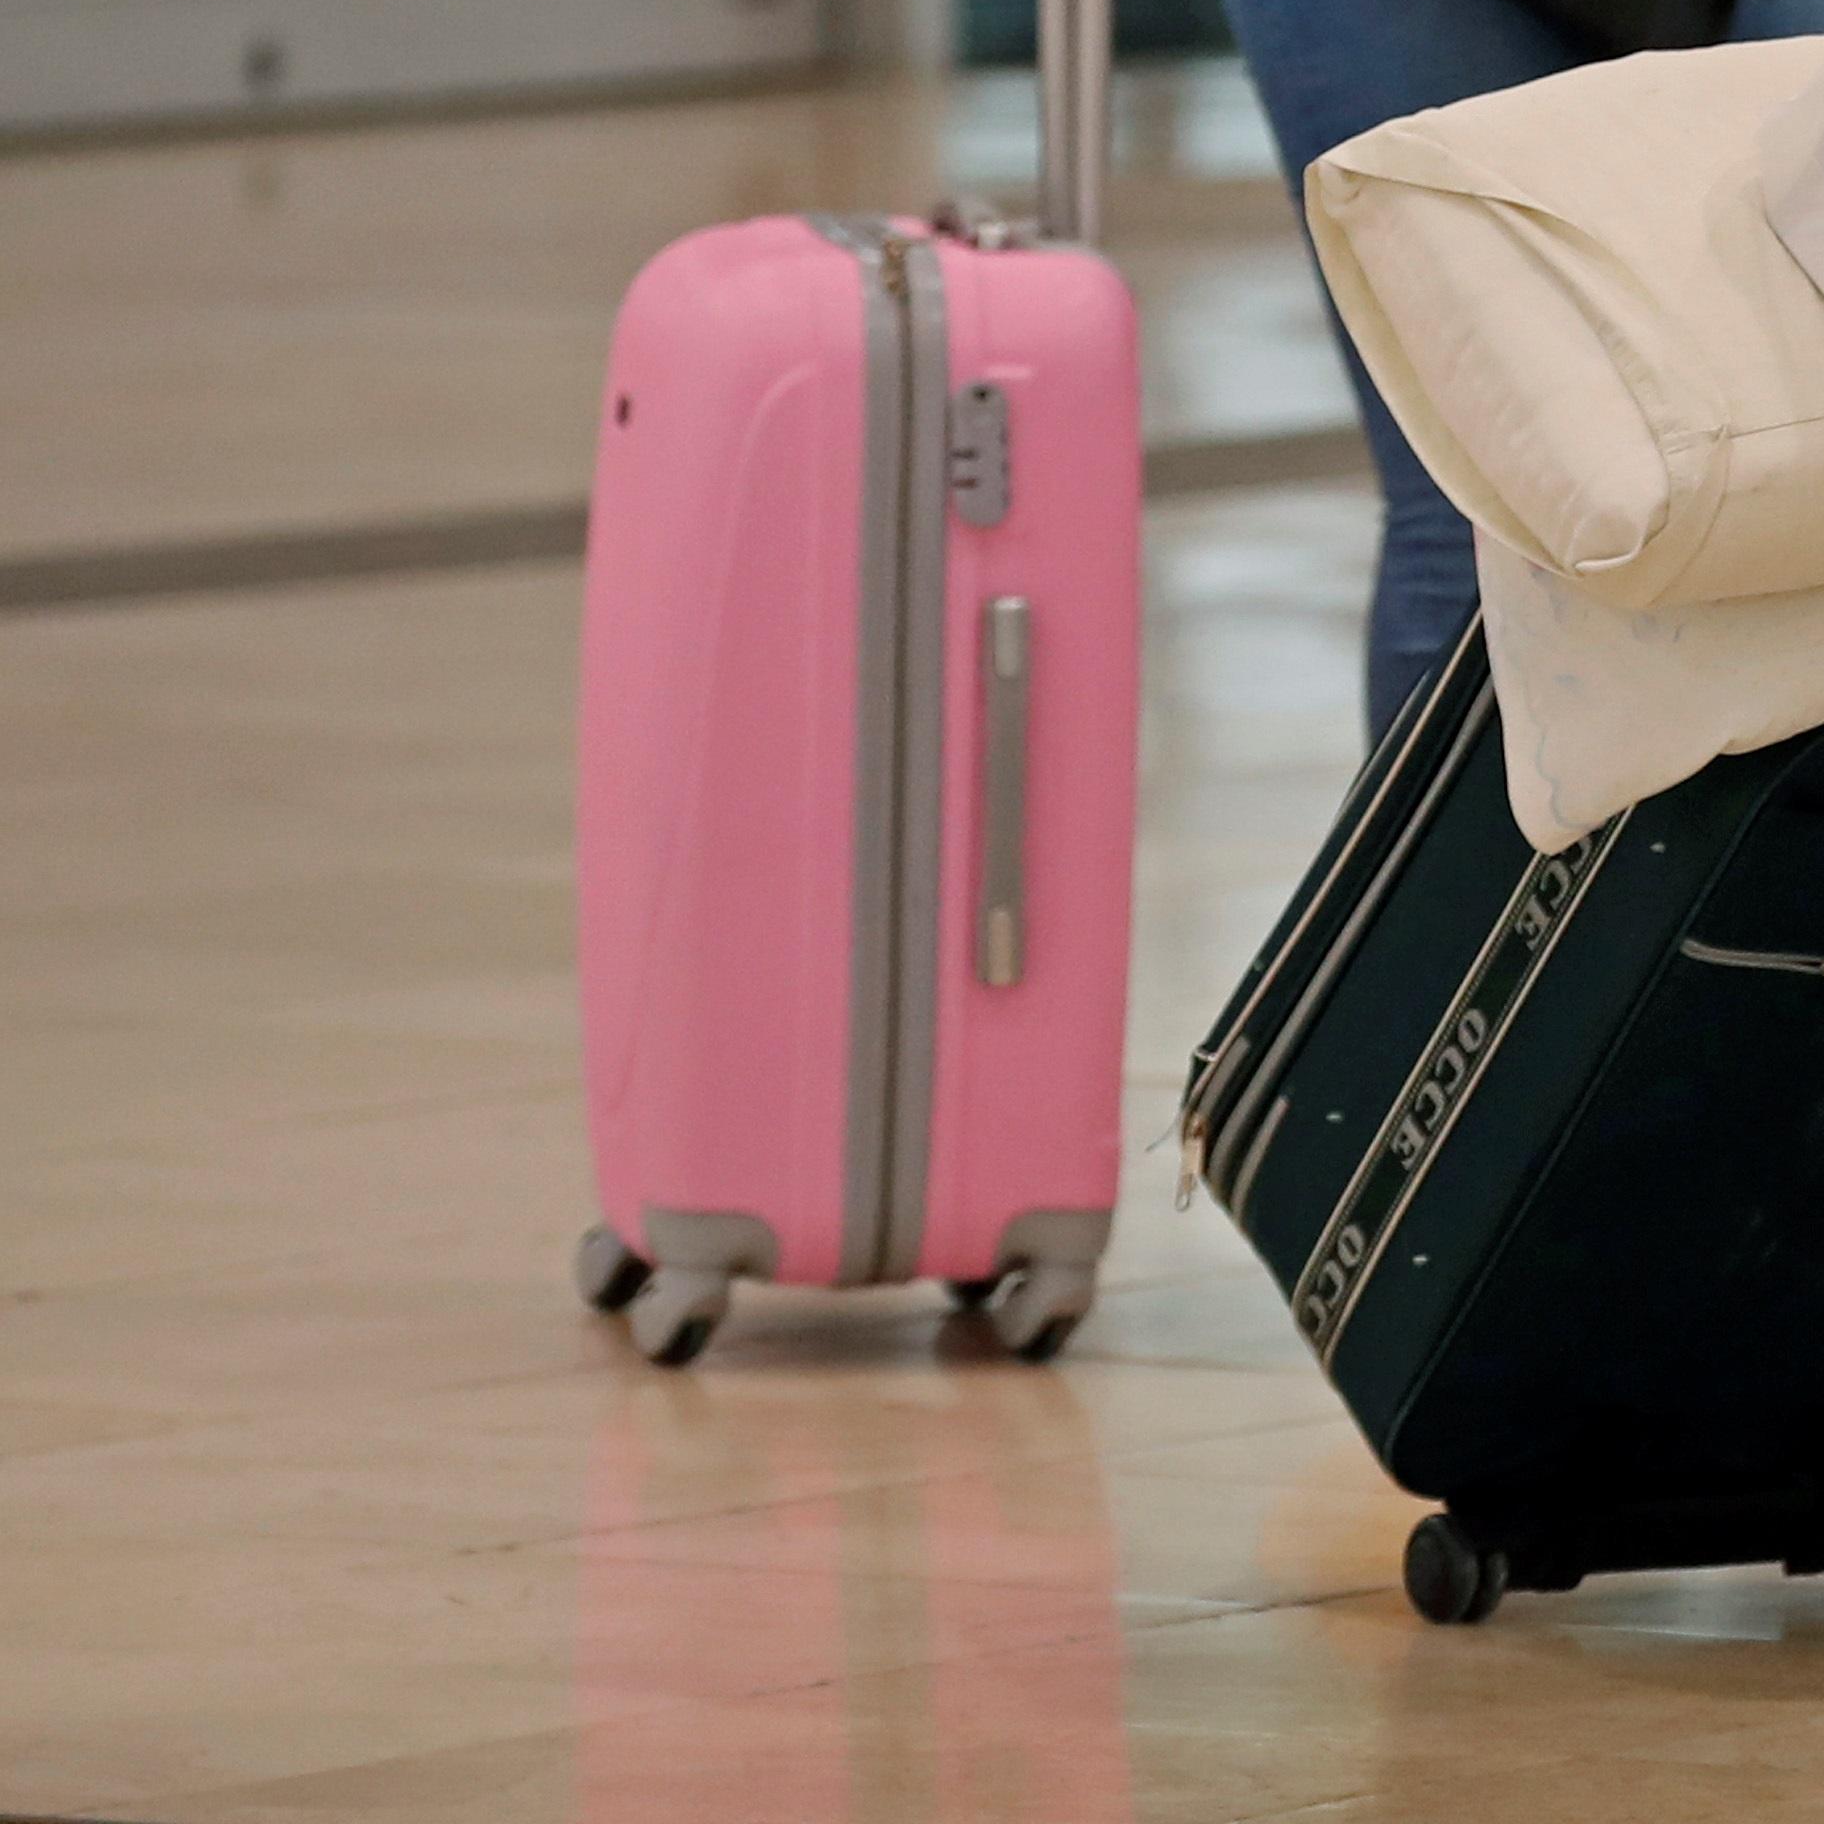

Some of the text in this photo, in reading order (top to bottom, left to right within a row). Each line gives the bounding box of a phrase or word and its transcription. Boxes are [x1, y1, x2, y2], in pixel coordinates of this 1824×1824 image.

[1306, 833, 1594, 1340] CCE OCCE OCC
